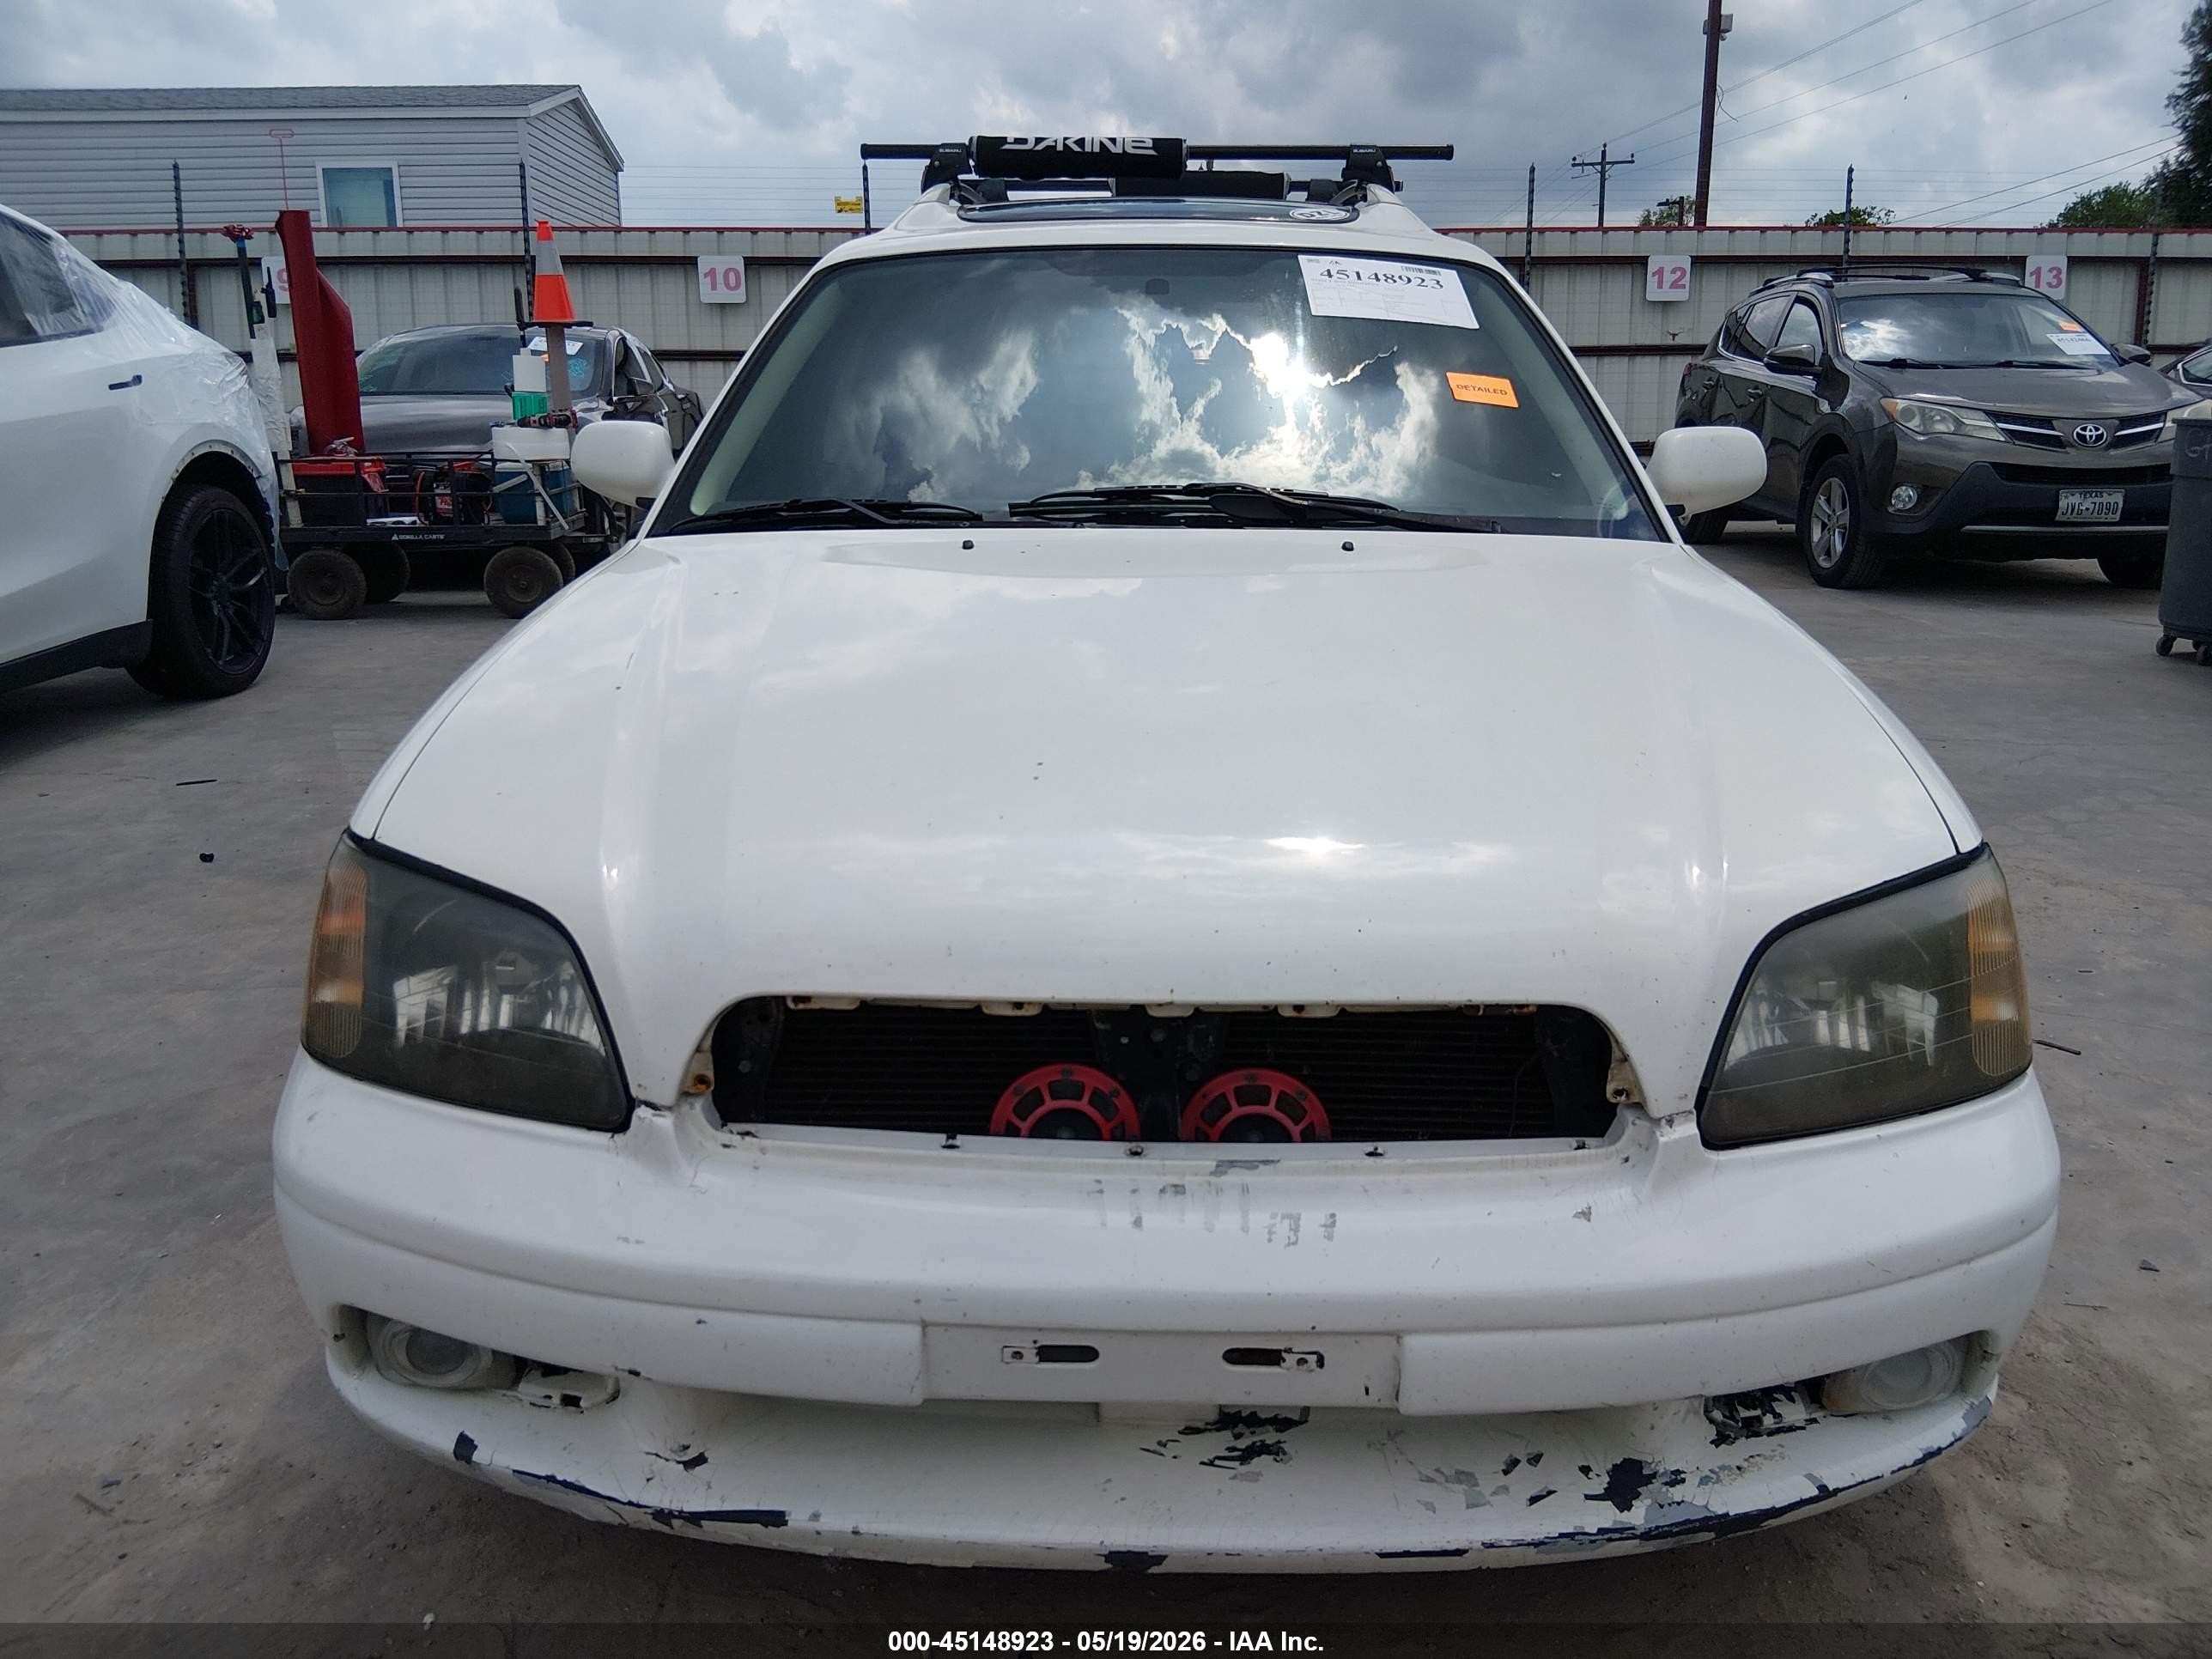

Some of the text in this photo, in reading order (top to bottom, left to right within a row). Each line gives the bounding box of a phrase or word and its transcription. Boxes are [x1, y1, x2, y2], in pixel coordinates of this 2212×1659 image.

[703, 267, 742, 291] 10
[1320, 268, 1443, 290] 45148923
[1651, 266, 1687, 289] 12
[2029, 266, 2063, 289] 13
[1455, 384, 1508, 396] DETAILED
